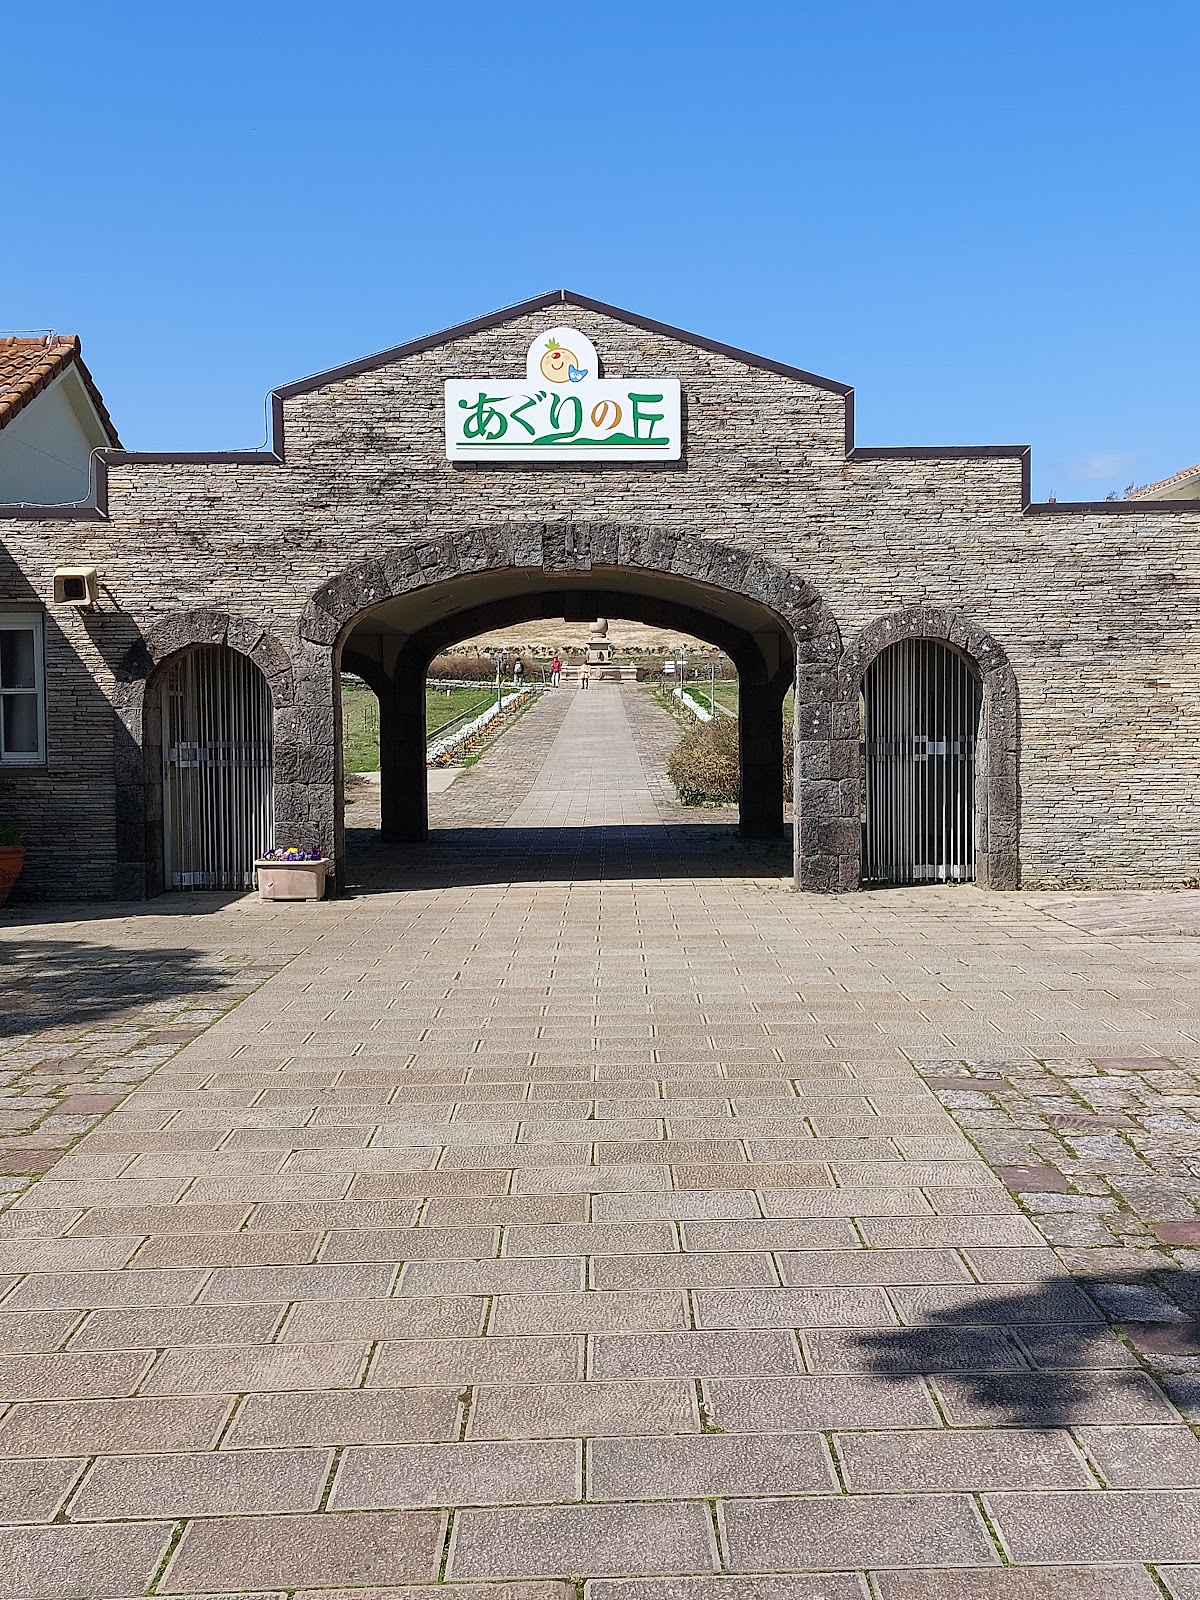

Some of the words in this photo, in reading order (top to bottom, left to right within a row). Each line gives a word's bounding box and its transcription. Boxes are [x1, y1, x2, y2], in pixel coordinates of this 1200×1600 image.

[458, 390, 670, 445] あぐりの丘
